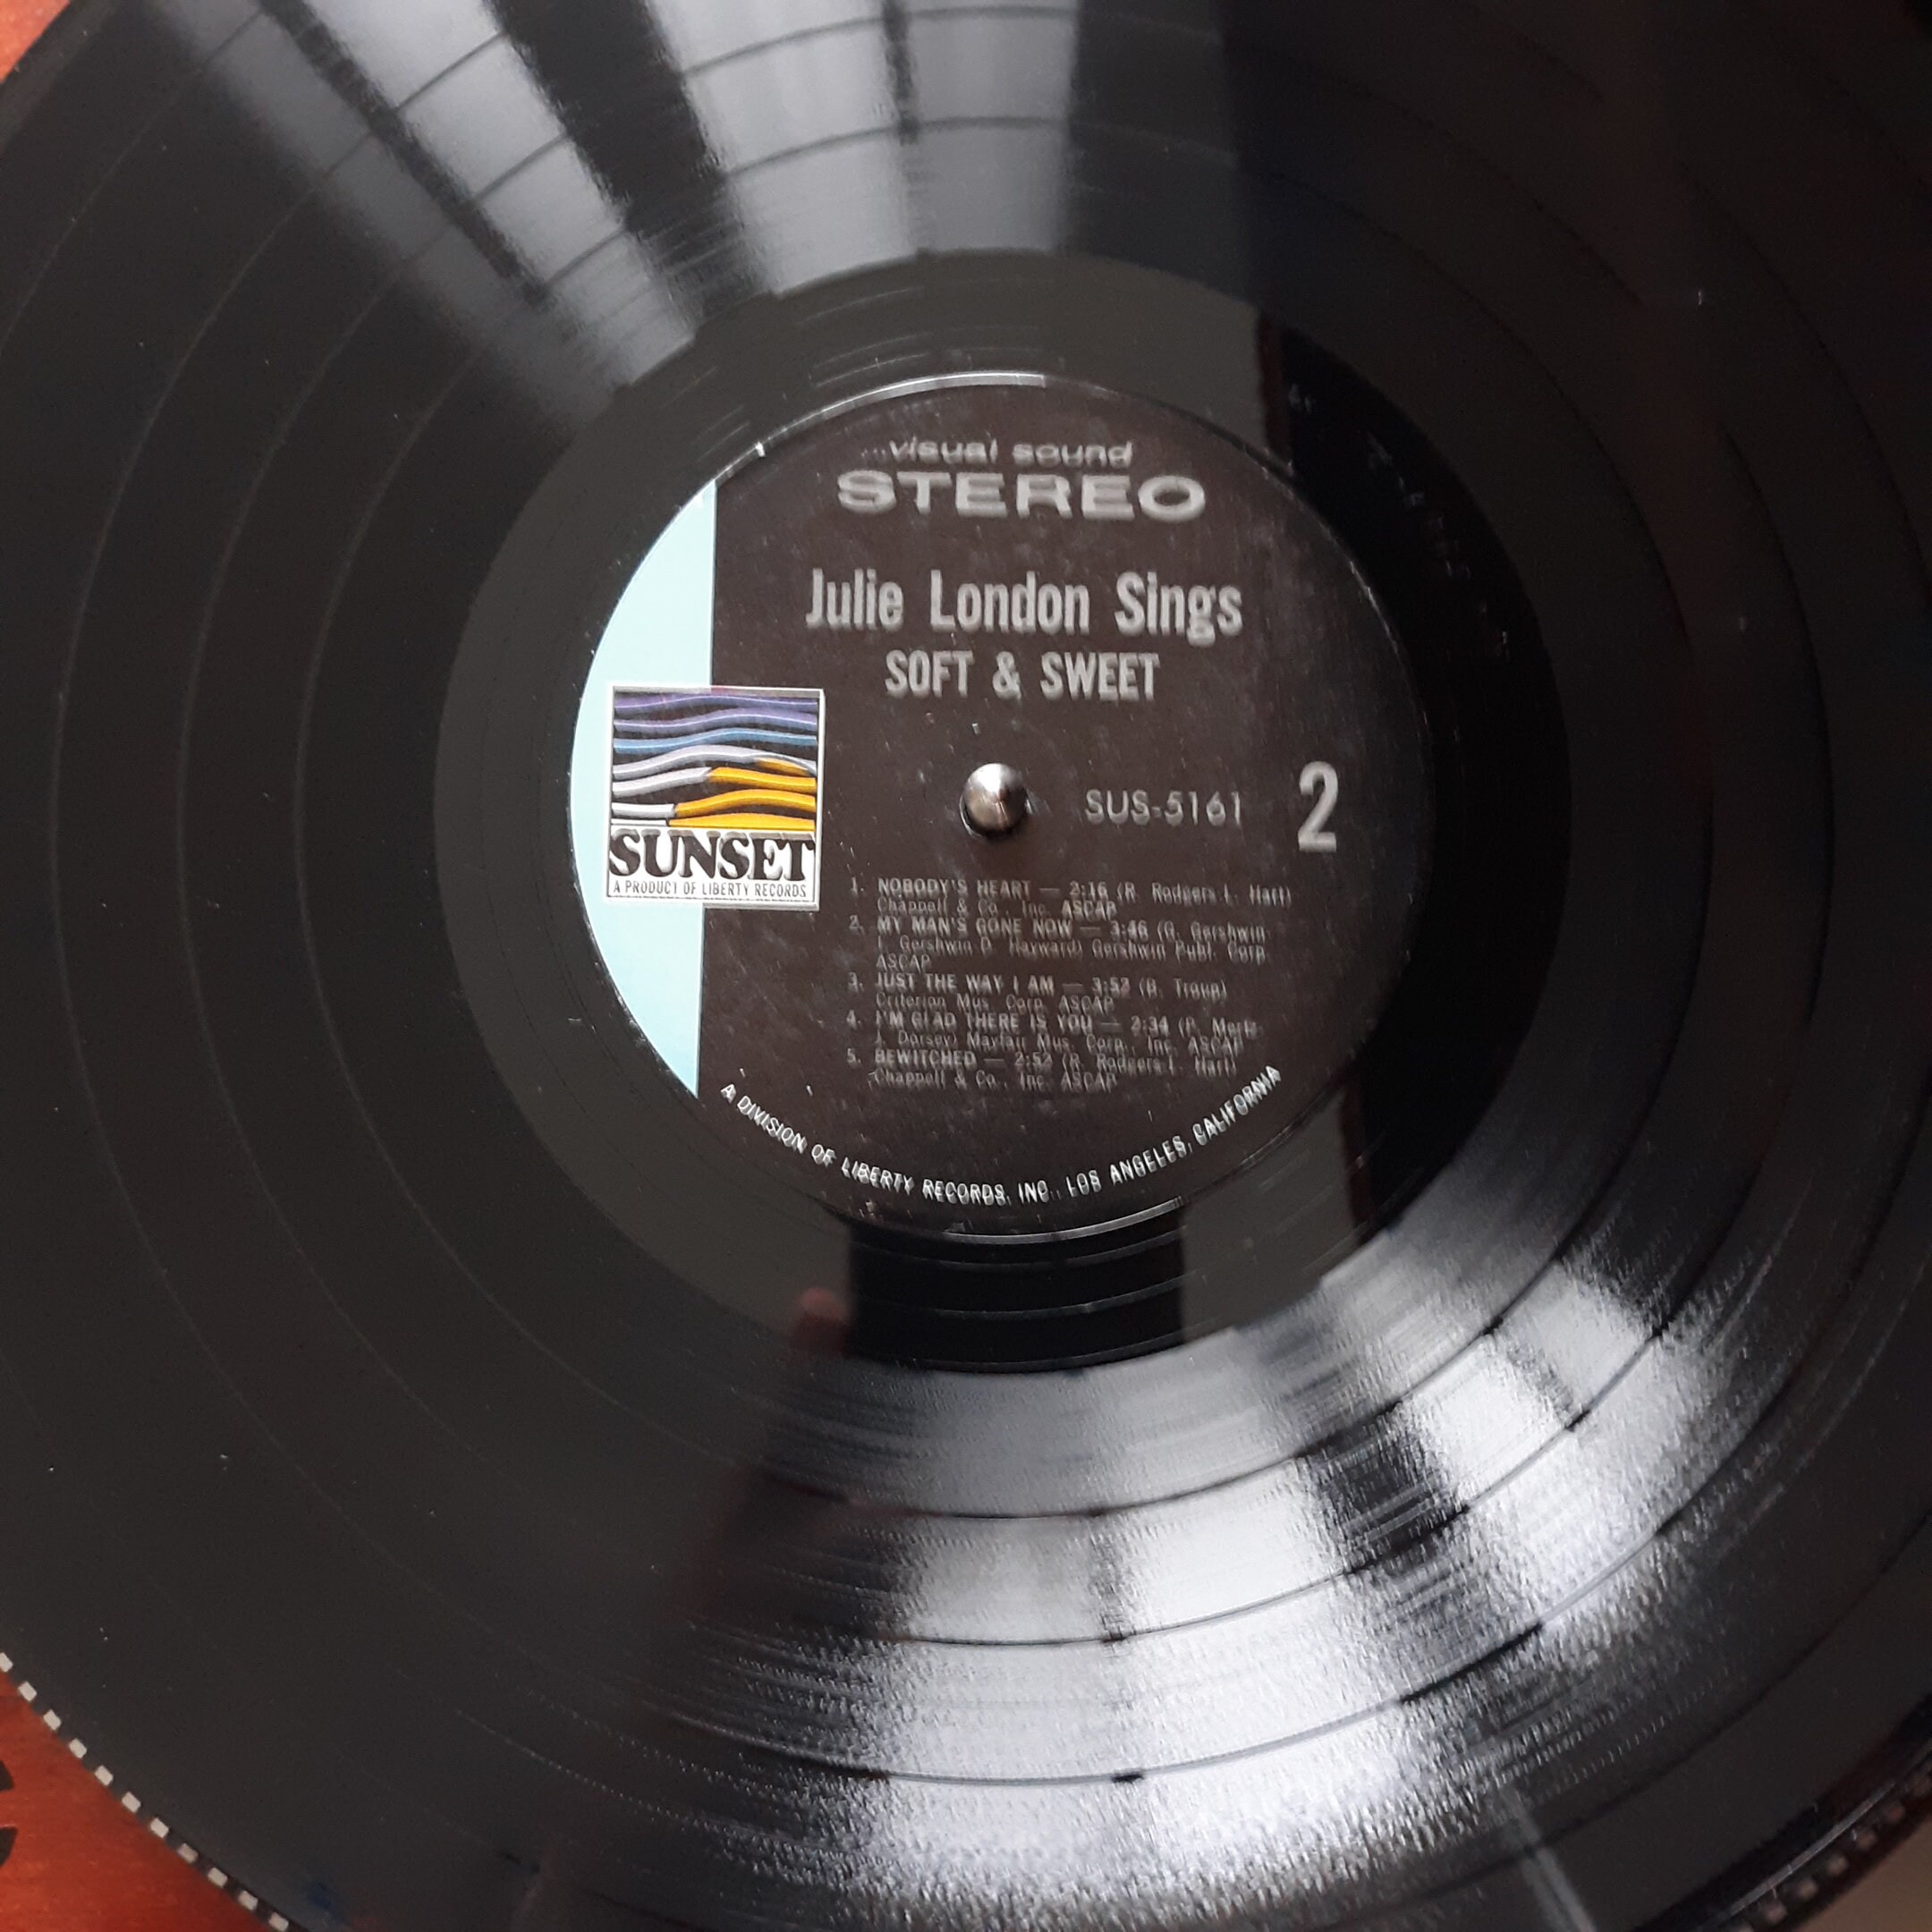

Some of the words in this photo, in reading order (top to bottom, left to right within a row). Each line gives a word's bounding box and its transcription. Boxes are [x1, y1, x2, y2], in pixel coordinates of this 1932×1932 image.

[1012, 441, 1132, 468] sound
[838, 470, 1206, 522] STEREO
[805, 567, 903, 630] Julie
[930, 570, 1090, 633] London
[1114, 571, 1243, 647] Sings
[885, 649, 974, 699] SOFT
[992, 652, 1021, 699] &
[1039, 652, 1160, 701] SWEET
[1085, 789, 1241, 826] SUS-5161
[1298, 761, 1338, 852] 2
[609, 828, 816, 881] SUNSET
[614, 881, 620, 893] A
[625, 881, 678, 894] PRODUCT
[684, 882, 697, 894] OF
[702, 882, 749, 896] LIBERTY
[755, 884, 807, 897] RECORDS
[877, 878, 968, 897] NOBODY'S
[977, 879, 1030, 899] HEART
[957, 898, 968, 916] &
[1061, 900, 1117, 920] ASCAP
[877, 915, 901, 935] MY
[911, 916, 968, 936] MAN'S
[976, 918, 1022, 936] GONE
[1031, 918, 1073, 939] NOW
[876, 953, 931, 972] ASCAP
[876, 972, 915, 992] JUST
[925, 973, 957, 993] THE
[966, 974, 1003, 994] WAY
[1013, 976, 1019, 994] I
[1028, 976, 1055, 996] AM
[1059, 996, 1114, 1015] ASCAP
[966, 1013, 1019, 1032] THERE
[1030, 1013, 1047, 1033] IS
[1057, 1014, 1093, 1035] YOU
[875, 1049, 978, 1071] BEWITCHED
[954, 1070, 967, 1090] &
[1061, 1072, 1117, 1093] ASCAP
[720, 1083, 737, 1104] A
[737, 1096, 808, 1154] DIVISION
[811, 1144, 836, 1166] OF
[842, 1157, 915, 1195] LIBERTY
[1066, 1170, 1102, 1197] LOS
[1192, 1065, 1281, 1146] CALIFORNIA
